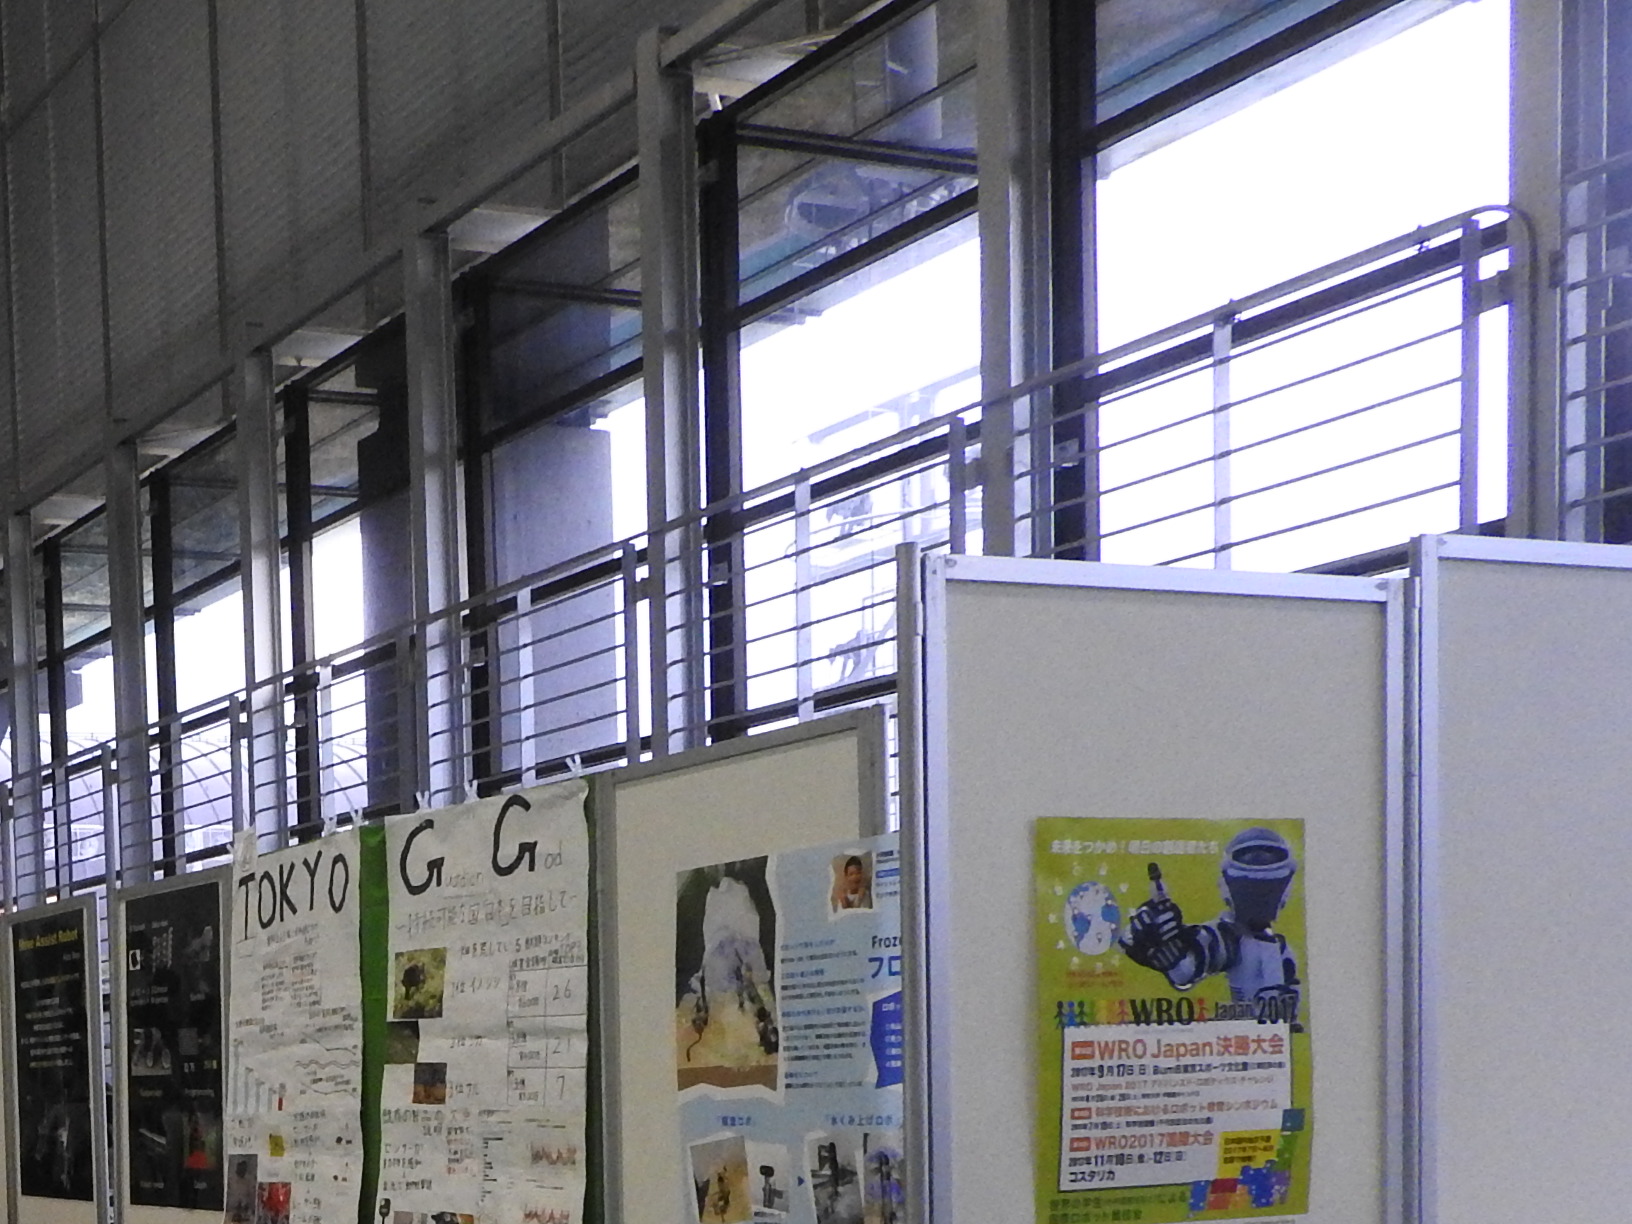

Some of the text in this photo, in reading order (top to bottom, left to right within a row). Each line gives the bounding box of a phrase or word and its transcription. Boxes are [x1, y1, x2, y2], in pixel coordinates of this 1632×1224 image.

[239, 850, 349, 940] TOKYO
[553, 979, 572, 1001] 26
[1130, 997, 1195, 1026] WRO
[1096, 1038, 1148, 1061] WRO
[1069, 1170, 1116, 1184] コスタリカ
